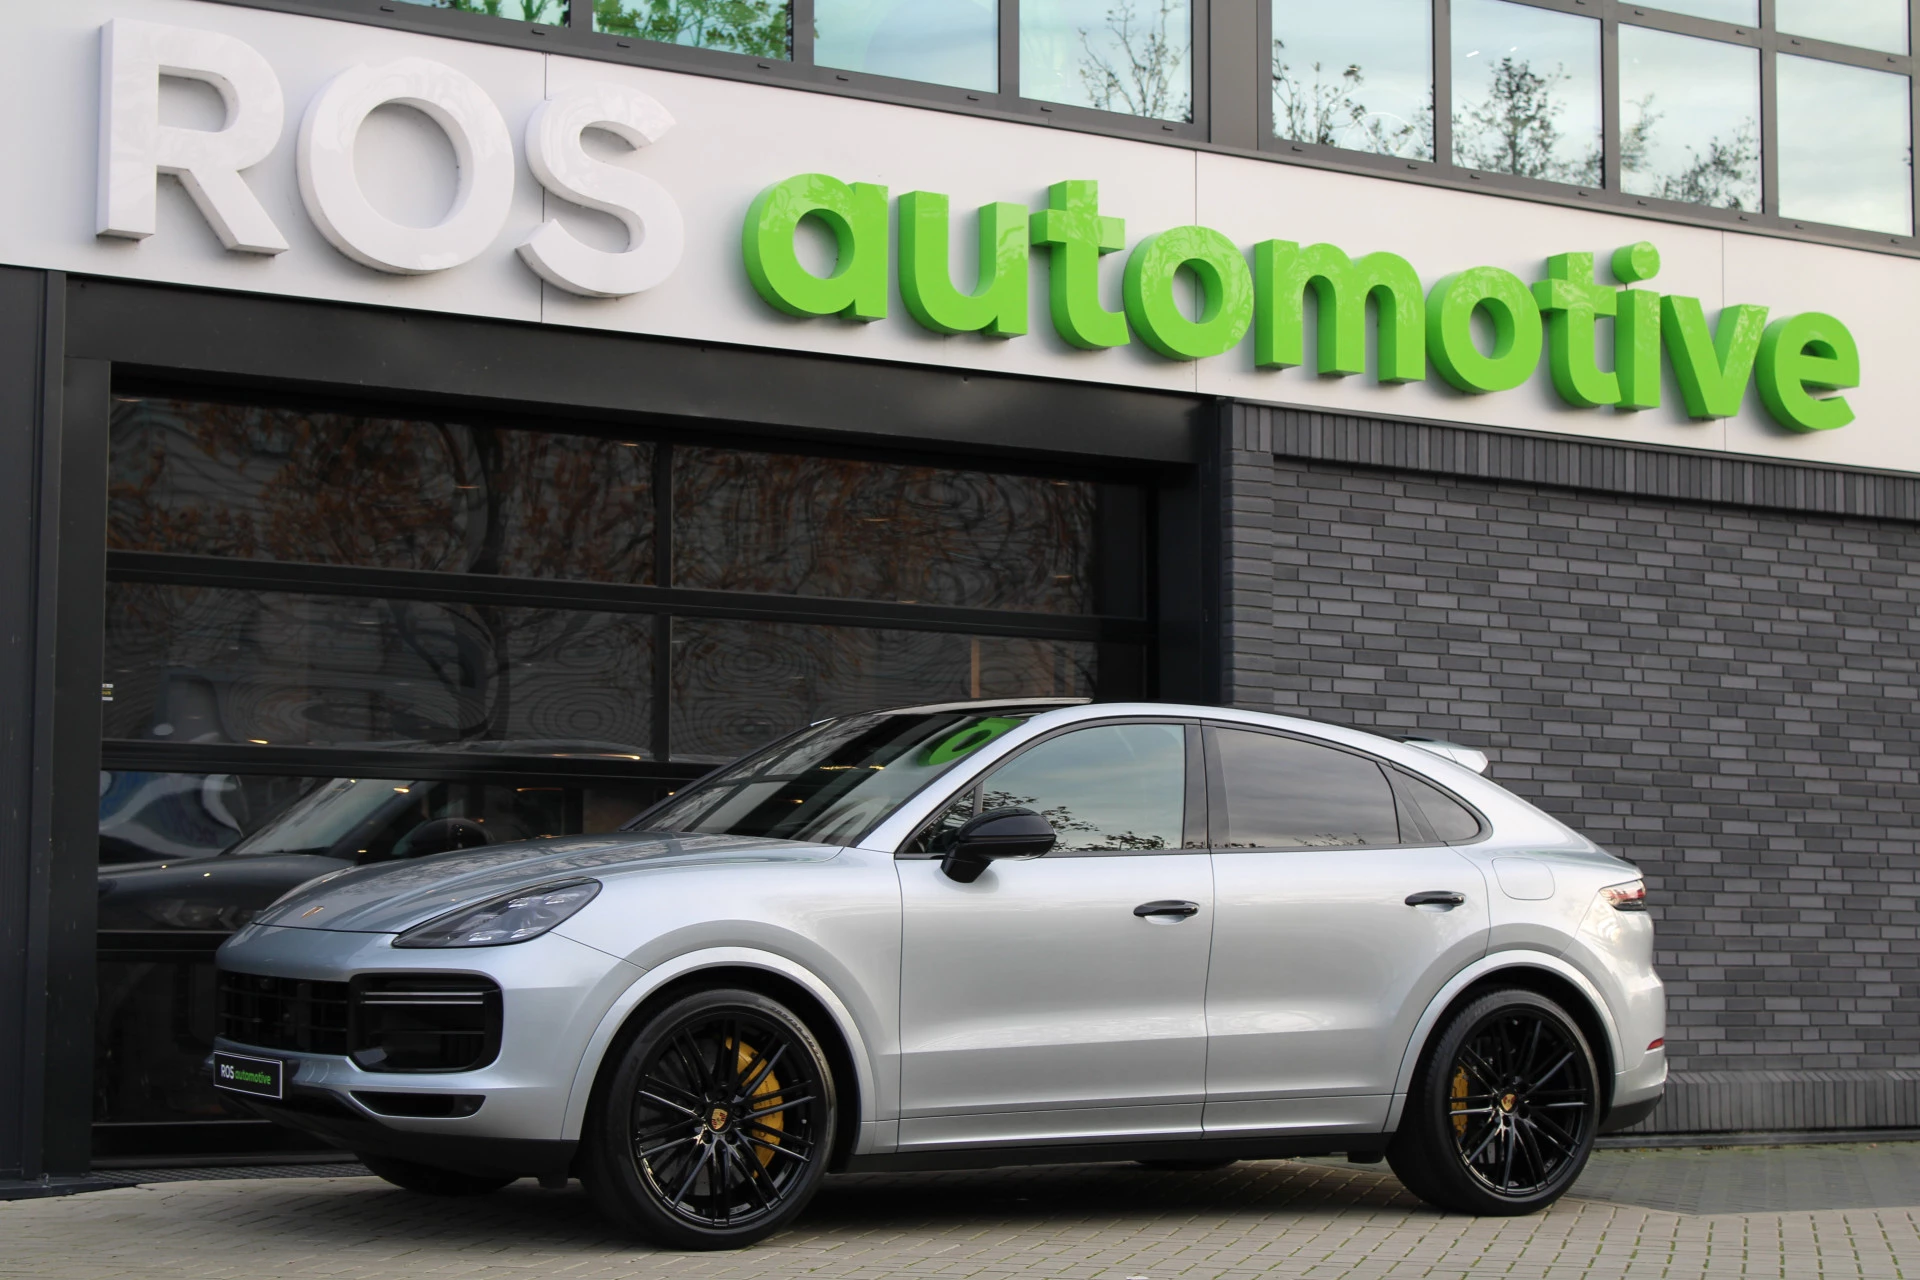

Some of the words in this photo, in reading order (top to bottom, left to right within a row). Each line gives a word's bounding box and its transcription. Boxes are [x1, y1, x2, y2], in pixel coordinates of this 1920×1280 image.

[97, 17, 684, 299] ROS
[742, 172, 1860, 433] automotive
[220, 1064, 235, 1080] ROS
[235, 1070, 272, 1085] automotive
